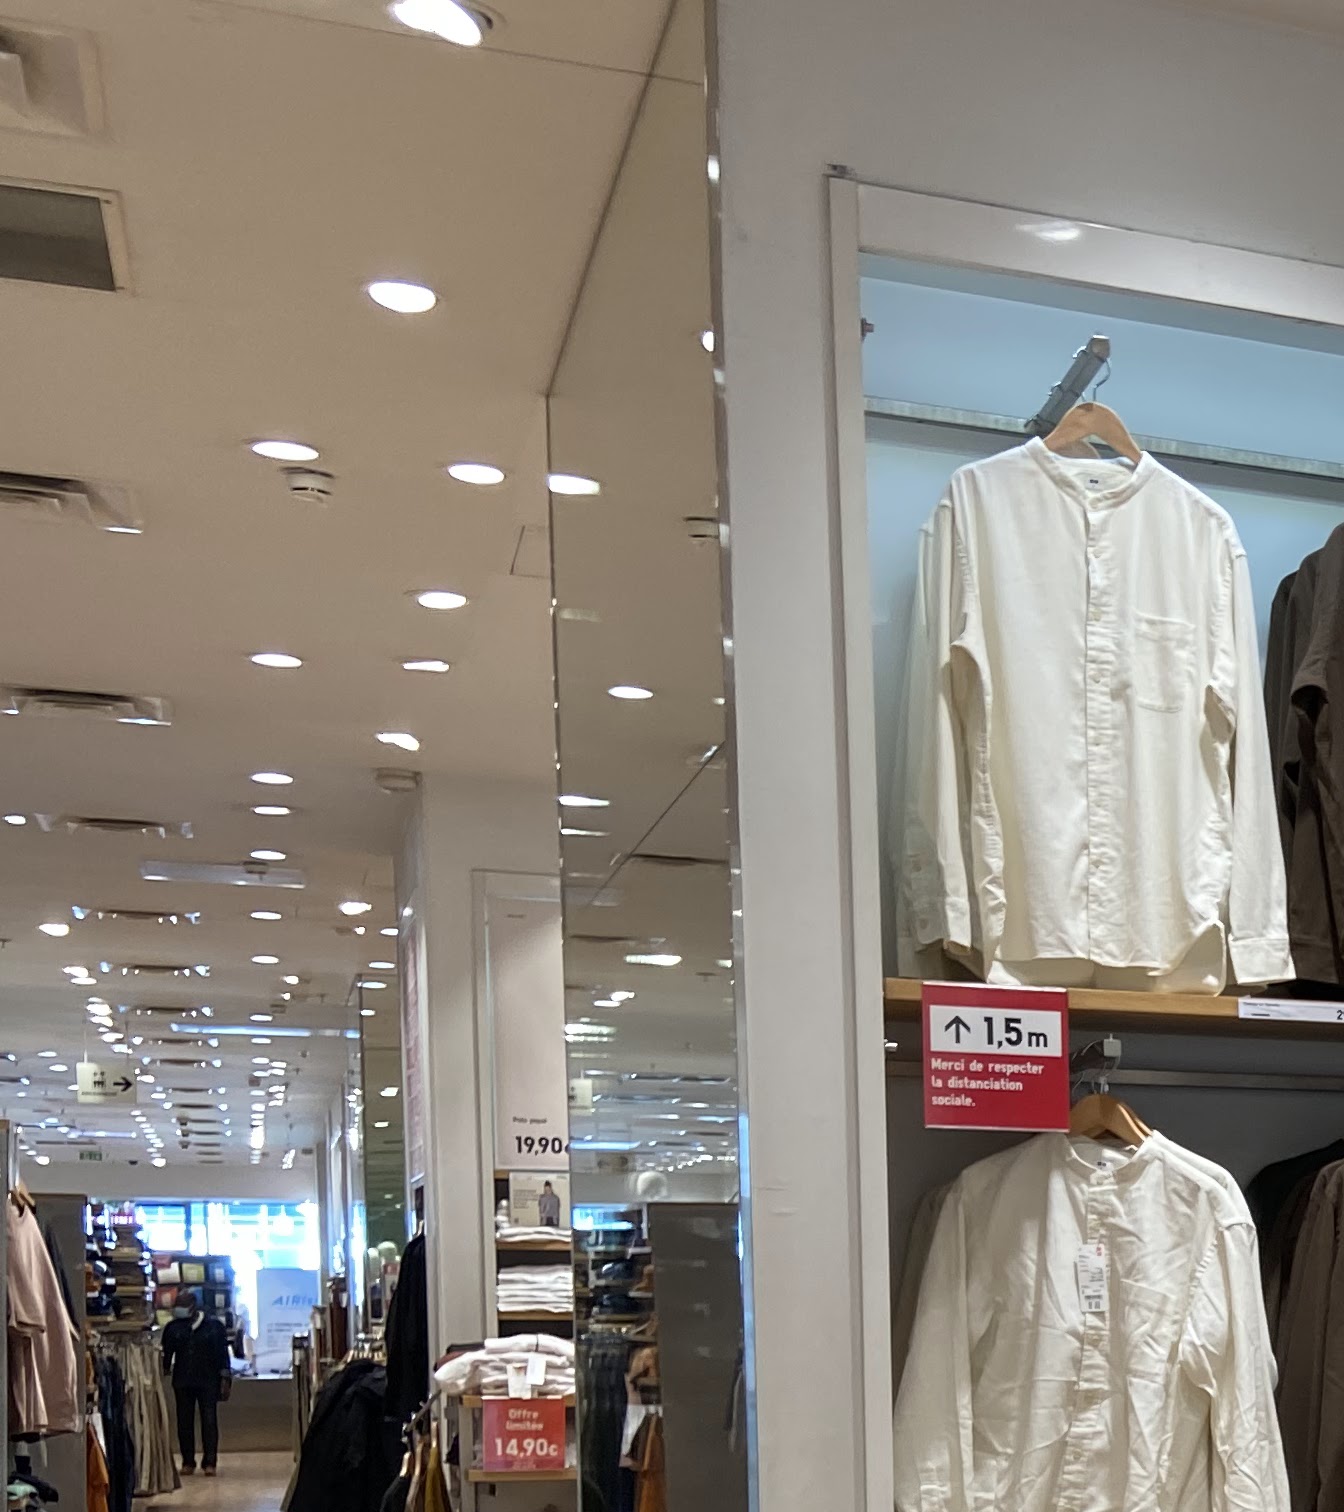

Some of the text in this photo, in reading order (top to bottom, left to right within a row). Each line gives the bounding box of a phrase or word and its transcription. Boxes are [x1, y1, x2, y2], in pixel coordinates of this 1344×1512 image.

[931, 1058, 1044, 1076] Merci de respecter
[931, 1075, 1023, 1091] la distanciation
[931, 1094, 976, 1107] sociale.
[508, 1408, 538, 1420] Offre
[495, 1438, 559, 1459] 14,90€
